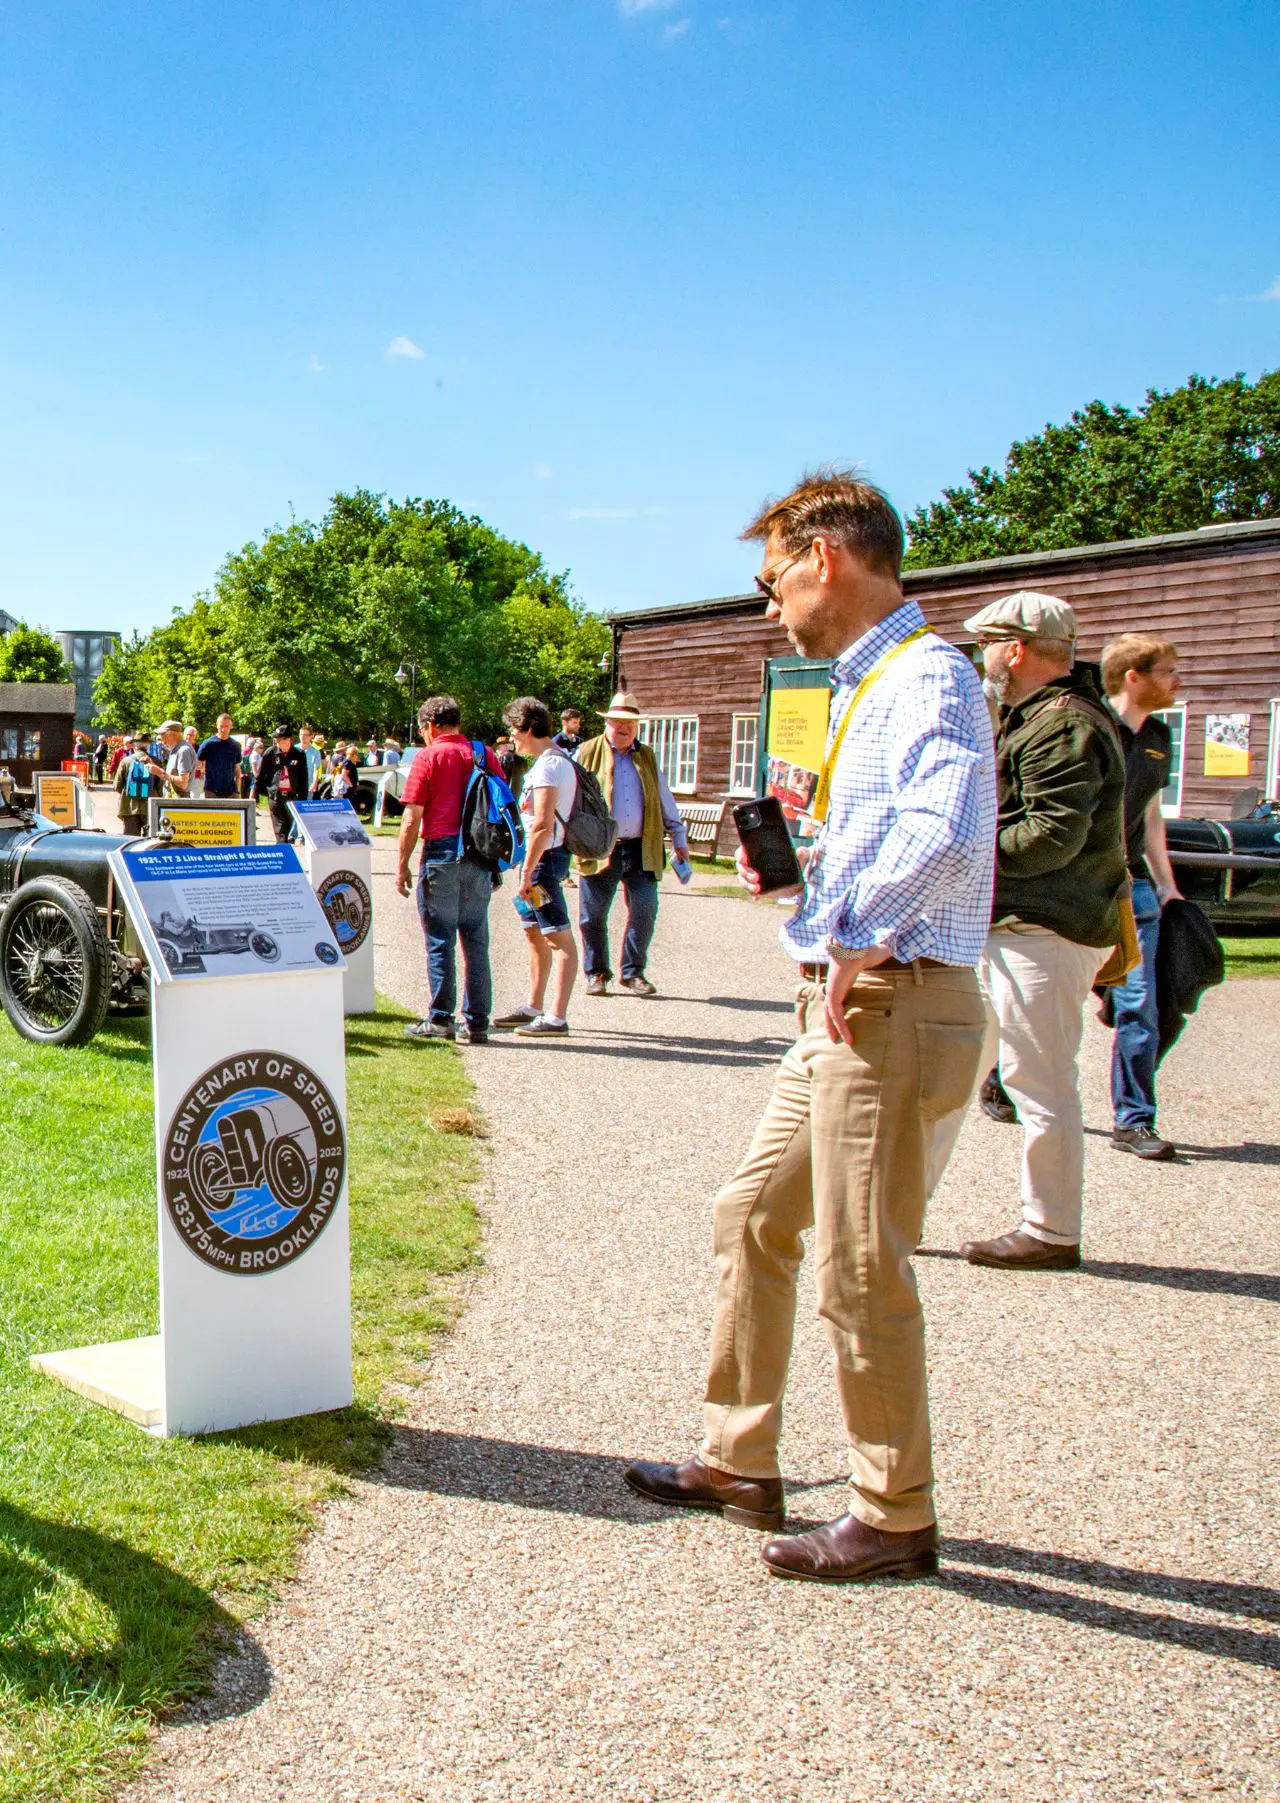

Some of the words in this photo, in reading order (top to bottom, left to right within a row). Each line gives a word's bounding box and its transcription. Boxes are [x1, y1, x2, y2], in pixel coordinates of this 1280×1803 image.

[182, 854, 203, 862] Litre
[204, 852, 238, 862] Straight
[344, 873, 356, 881] OF
[354, 878, 370, 904] SPEED
[170, 1058, 260, 1163] CENTENARY
[265, 1059, 293, 1080] OF
[293, 1072, 337, 1137] SPEED
[243, 1128, 259, 1162] 1
[320, 1146, 342, 1158] 2022
[166, 1168, 189, 1180] 1922
[239, 1166, 339, 1269] BROOKLANDS
